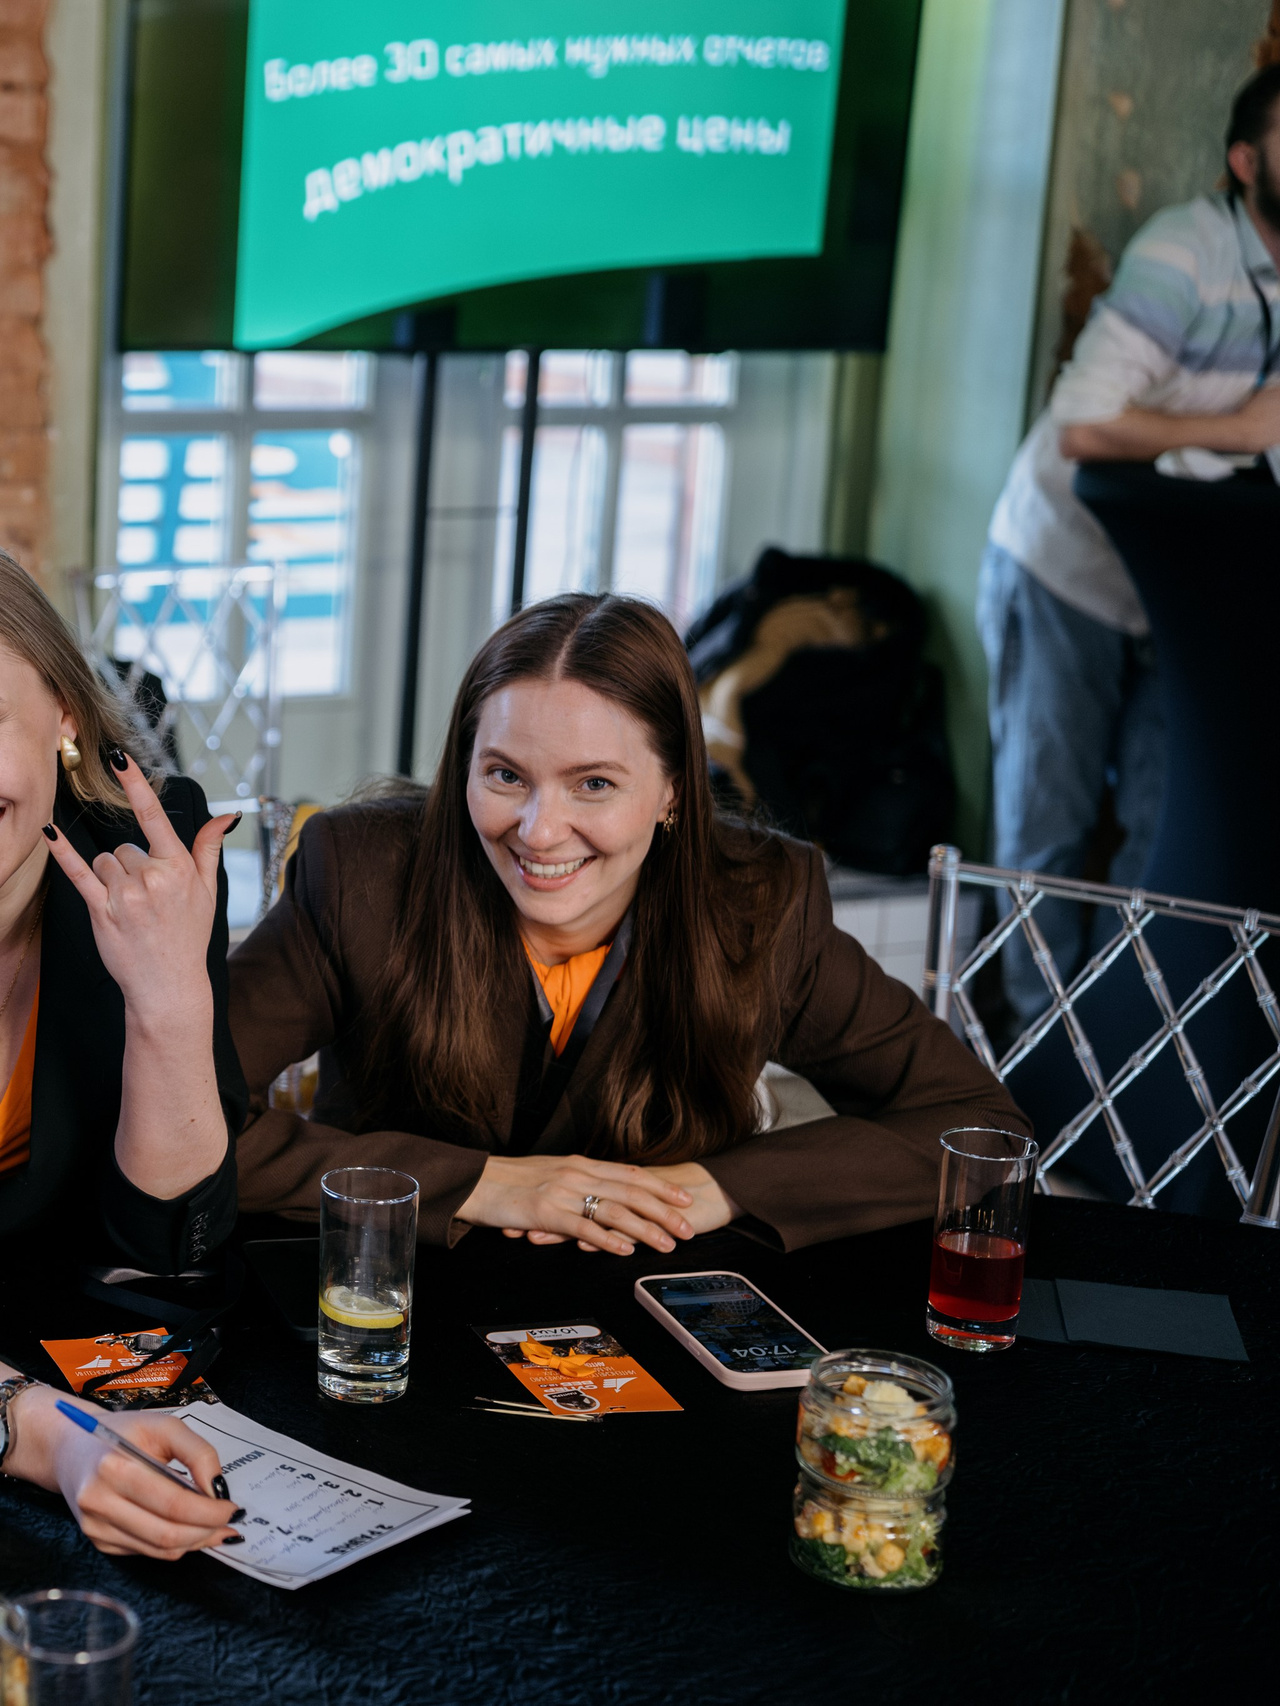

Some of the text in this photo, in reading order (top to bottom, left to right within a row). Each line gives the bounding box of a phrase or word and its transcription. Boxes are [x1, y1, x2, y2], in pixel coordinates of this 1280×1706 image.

[262, 33, 831, 102] Более 30 самых нужных отчетов
[303, 114, 793, 222] демократичные цены
[732, 1345, 797, 1358] 17:04
[221, 1450, 266, 1475] КОМАНД
